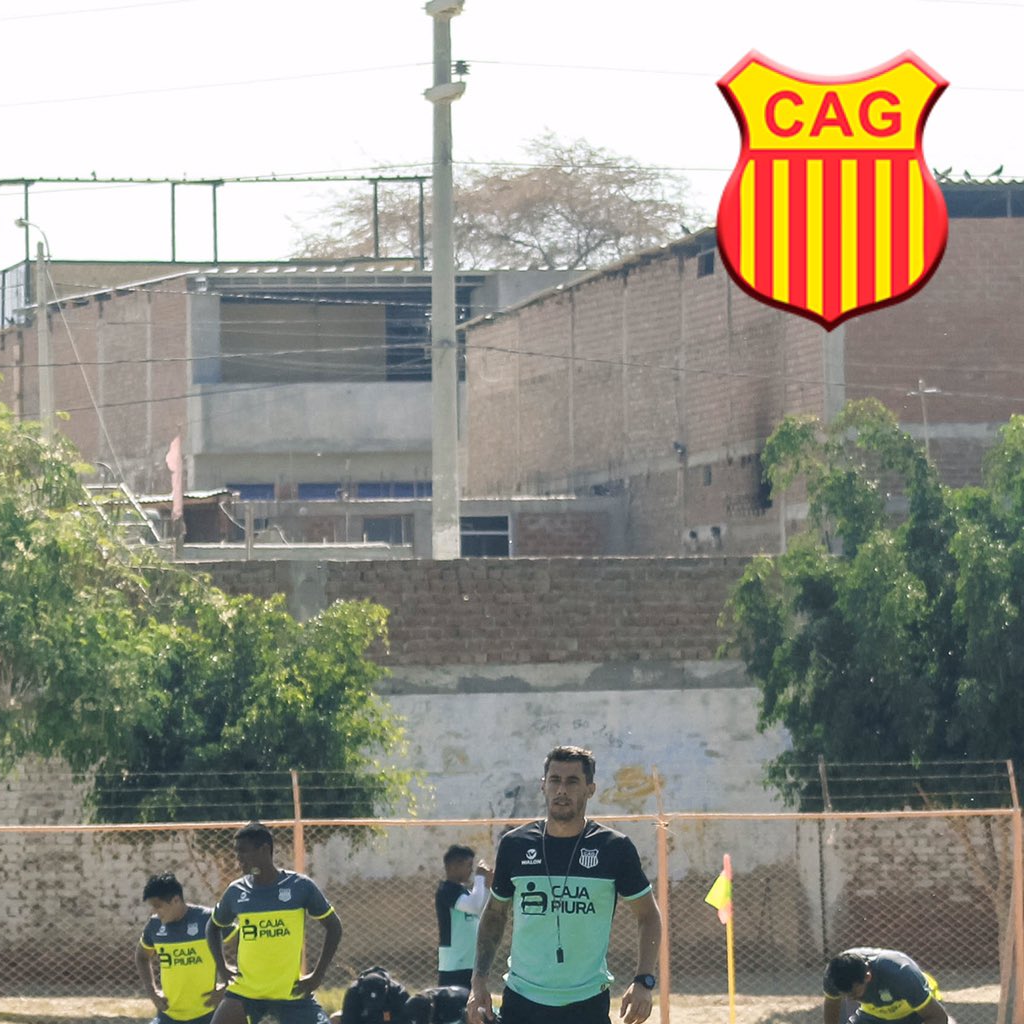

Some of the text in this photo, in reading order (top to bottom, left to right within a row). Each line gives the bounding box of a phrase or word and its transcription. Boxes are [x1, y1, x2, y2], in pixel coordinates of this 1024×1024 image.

[551, 885, 590, 900] CAJA
[551, 900, 596, 915] PIURA
[258, 919, 286, 929] CAJA
[259, 928, 291, 938] PIURA
[173, 947, 196, 957] CAJA
[174, 956, 203, 965] PIURA
